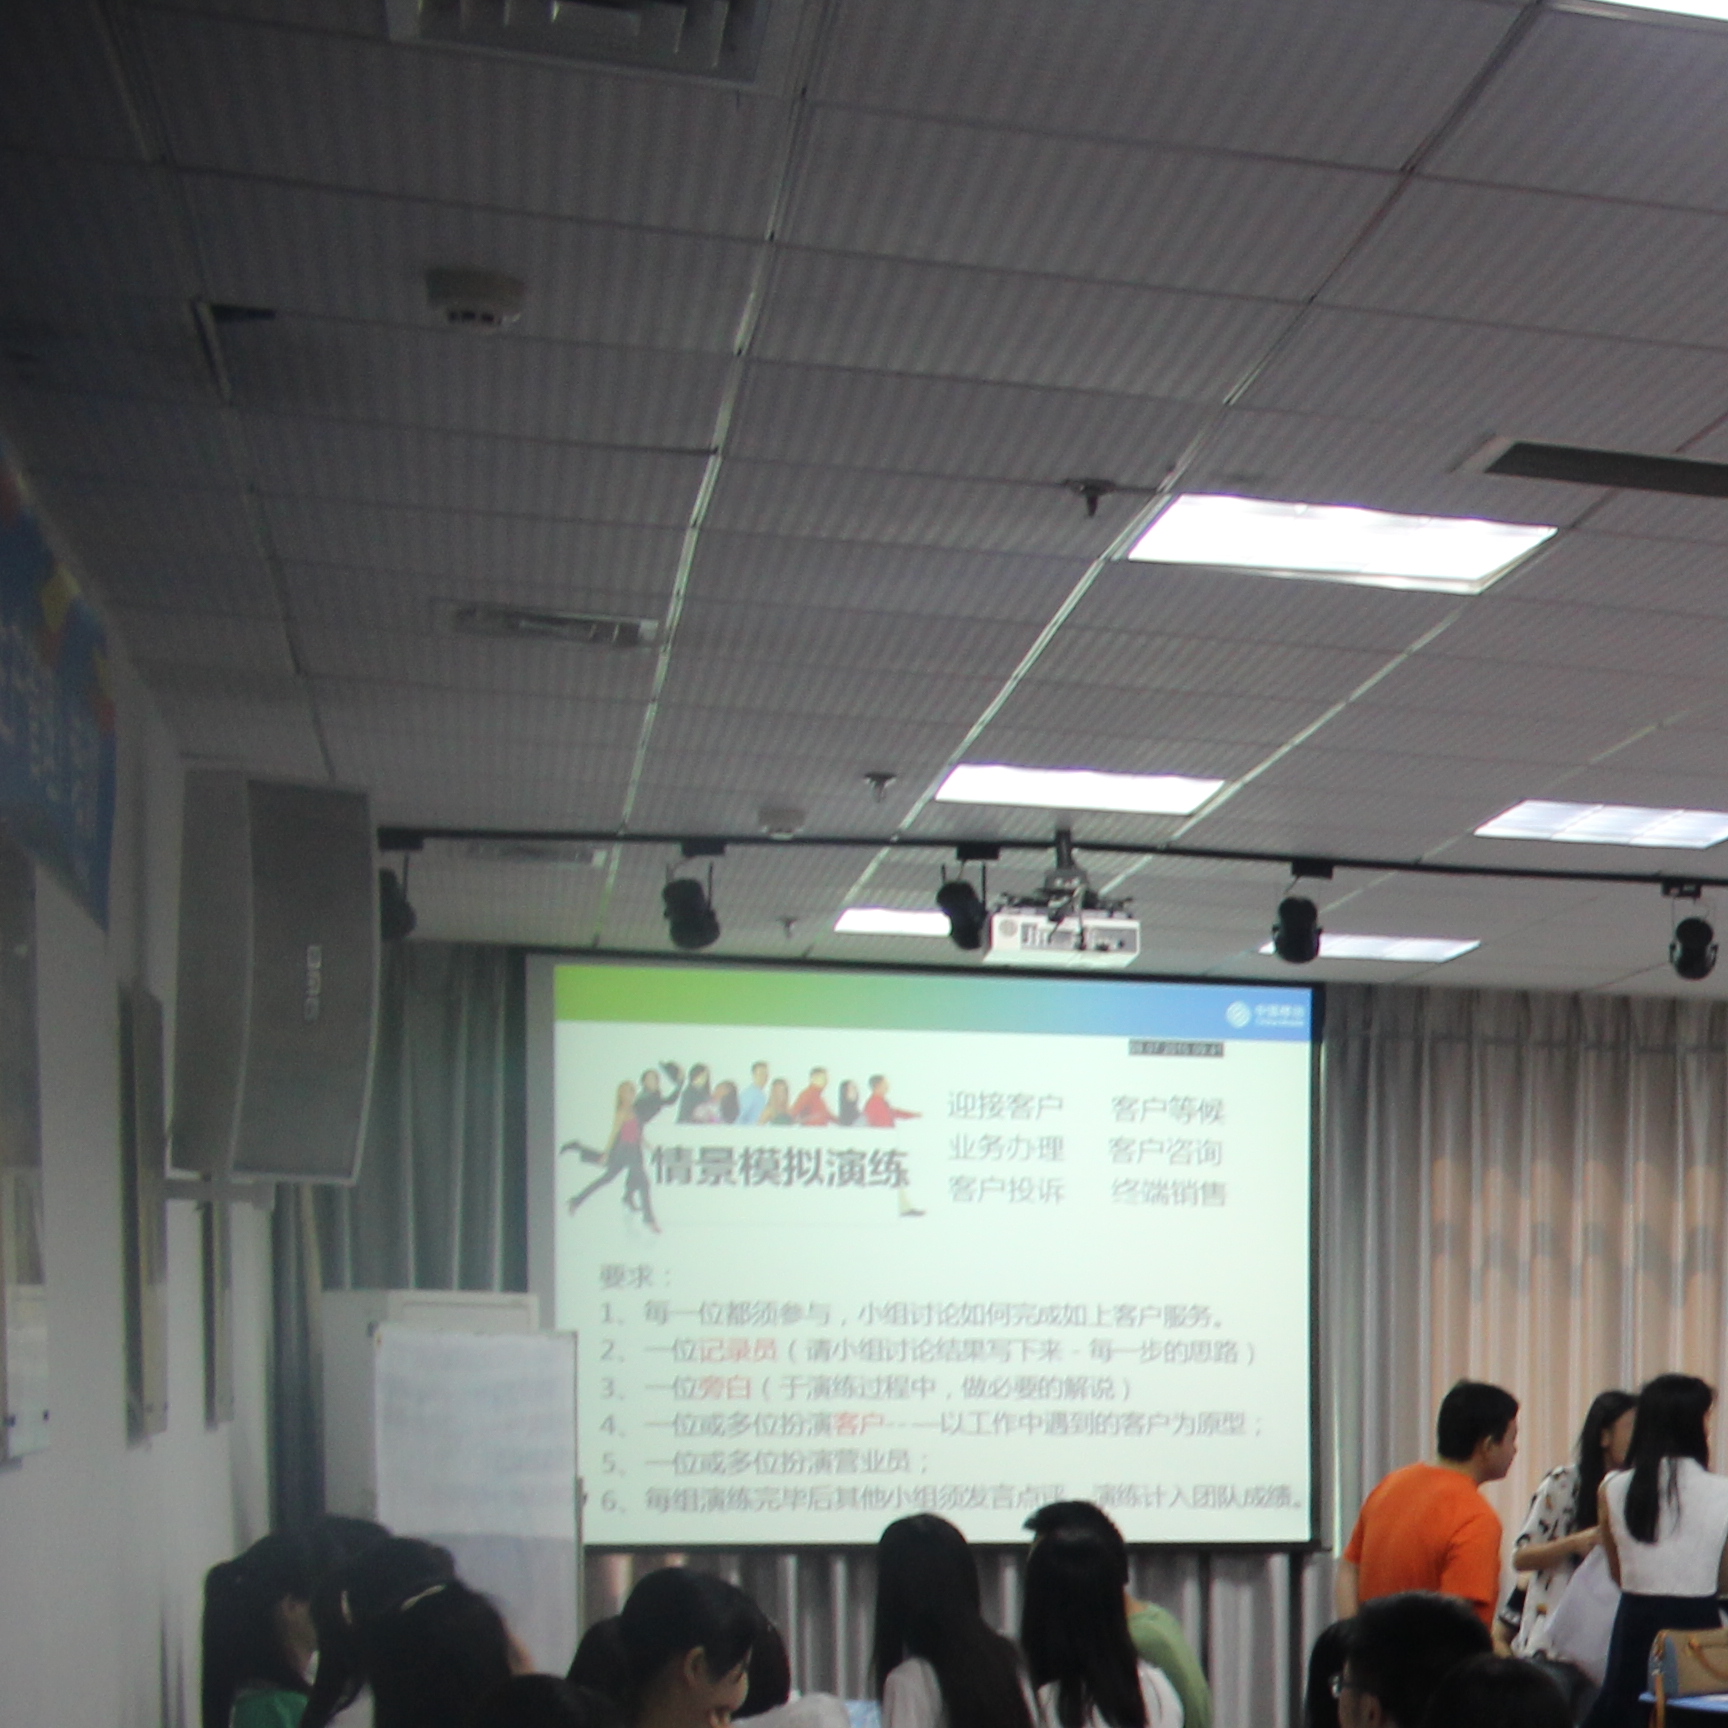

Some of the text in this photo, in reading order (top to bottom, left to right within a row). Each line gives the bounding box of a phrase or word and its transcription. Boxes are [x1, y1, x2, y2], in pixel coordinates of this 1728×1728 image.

[948, 1090, 1225, 1125] 迎接客户 客户等候
[650, 1145, 910, 1188] 情景模拟演练
[948, 1133, 1223, 1166] 业务办理 客户咨询
[948, 1175, 1226, 1207] 客户投诉 终端销售
